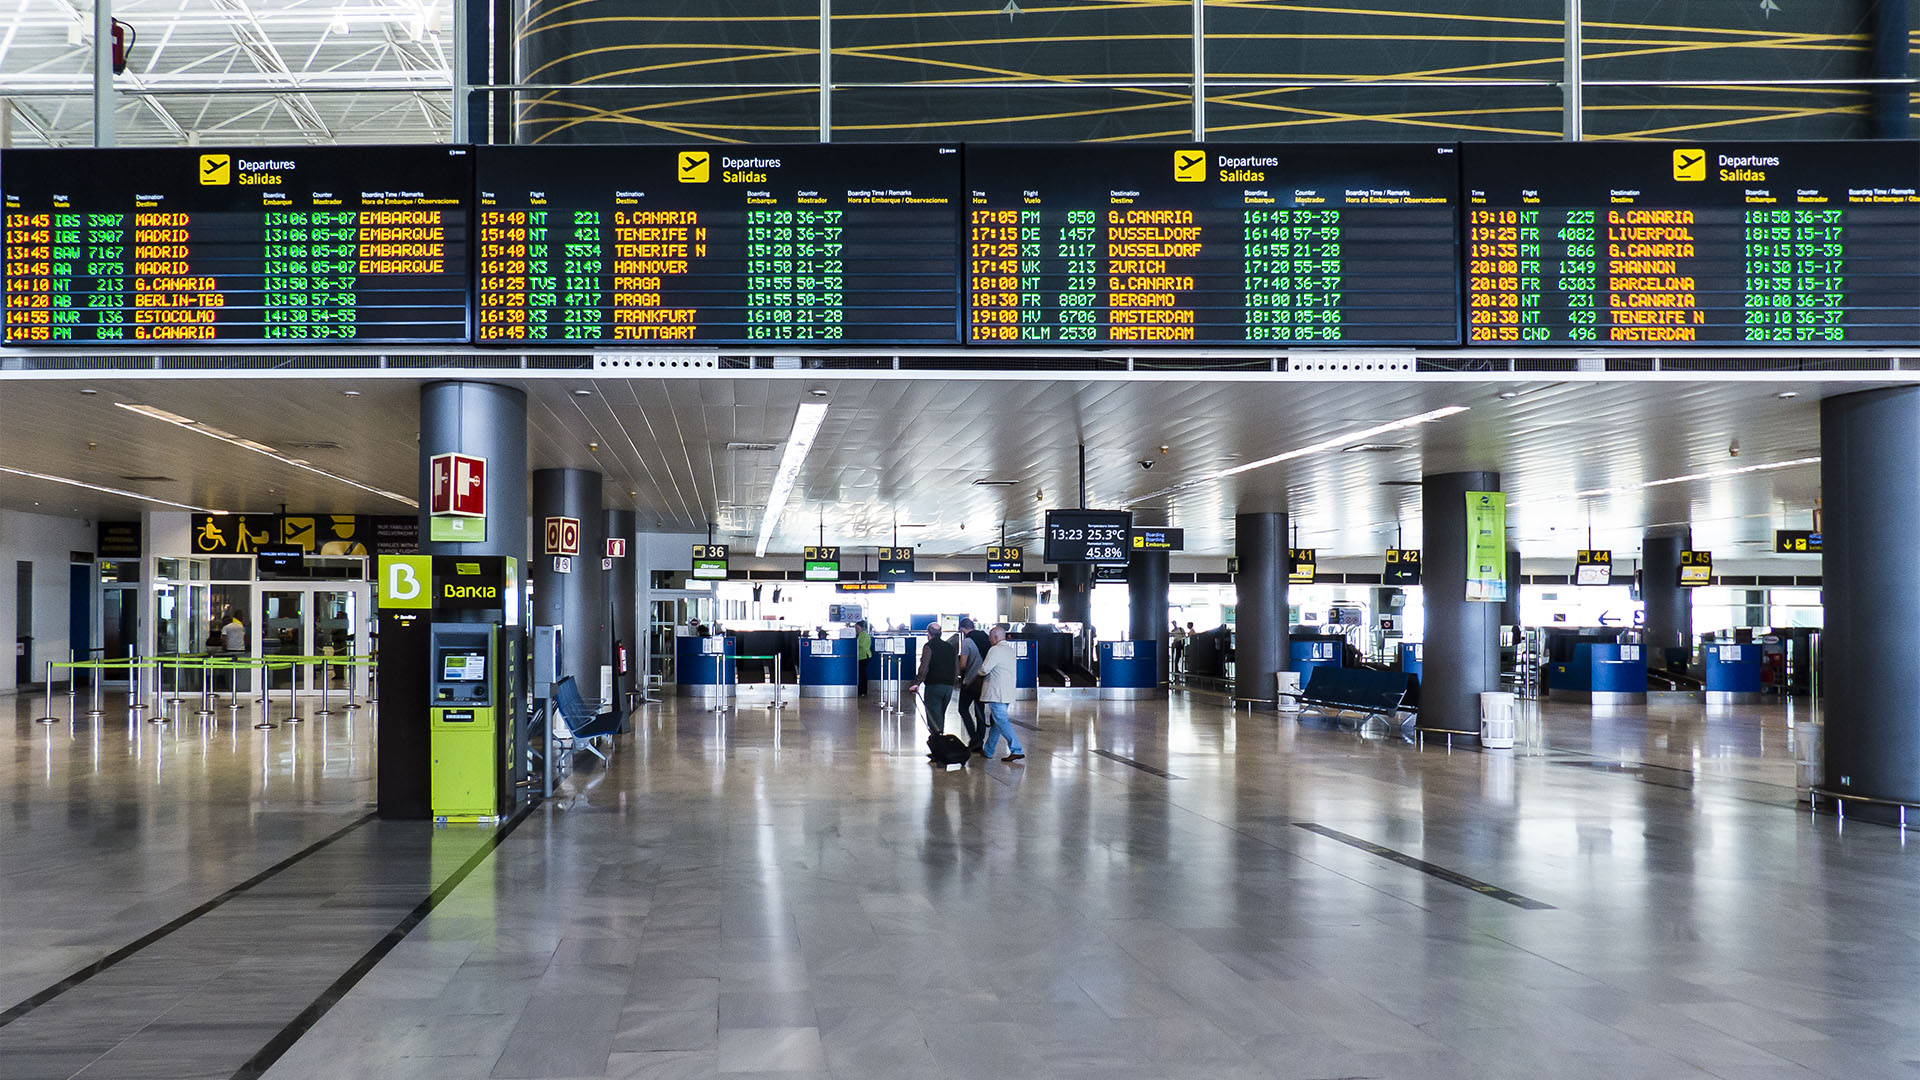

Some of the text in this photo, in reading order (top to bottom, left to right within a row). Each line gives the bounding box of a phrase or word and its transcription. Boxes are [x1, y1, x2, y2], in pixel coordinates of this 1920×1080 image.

[238, 159, 296, 172] Departures
[722, 156, 781, 170] Departures
[1218, 155, 1278, 169] Departures
[1718, 155, 1780, 168] Departures
[238, 173, 282, 185] Salidas
[722, 171, 767, 183] Salidas
[1219, 170, 1265, 182] Salidas
[1719, 169, 1766, 182] Salidas
[1023, 190, 1039, 198] Flight
[7, 211, 441, 227] 13:45 IBS 3907 MADRID 13:06 05-07 EMBARQUE
[481, 227, 842, 241] 15:40 NT 421 TENERIFE N 15:20 36-37
[972, 227, 1340, 241] 17:15 DE 1457 DUSSELDORF 16:40 57-59
[1471, 227, 1842, 241] 19:25 FR 4082 LIVERPOOL 18:55 15-17
[7, 260, 444, 276] 13:45 AA 8775 MADRID 13:06 05-07 EMBARQUE
[481, 260, 842, 275] 16:20 X3 2149 HANNOVER 15:50 21-22
[972, 260, 1340, 274] 17:45 WK 213 ZURICH 17:20 55-55
[1470, 260, 1843, 274] 20:00 FR 1349 SHANNON 19:30 15-17
[7, 293, 355, 308] 14:20 AB 2213 BERLIN-TEG 13:50 57-58
[973, 293, 1341, 308] 18:30 FR 8807 BERGAMO 18:00 15-17
[481, 309, 842, 324] 16:30 X3 2139 FRANKFURT 16:00 21-28
[1471, 310, 1844, 325] 20:30 NT 429 TENERIFE N 20:10 36-37
[973, 326, 1341, 340] 19:00 KLM 2530 AMSTERDAM 18:30 05-06
[1051, 529, 1083, 540] 13:23
[709, 546, 725, 558] 36
[820, 548, 836, 560] 37
[896, 549, 911, 560] 38
[1003, 548, 1019, 560] 39
[1086, 547, 1122, 558] 45.8%
[1298, 550, 1312, 561] 41
[1402, 551, 1418, 562] 42
[1594, 551, 1609, 563] 44
[1696, 552, 1710, 563] 45
[389, 563, 421, 600] B
[444, 584, 496, 598] Bankia
